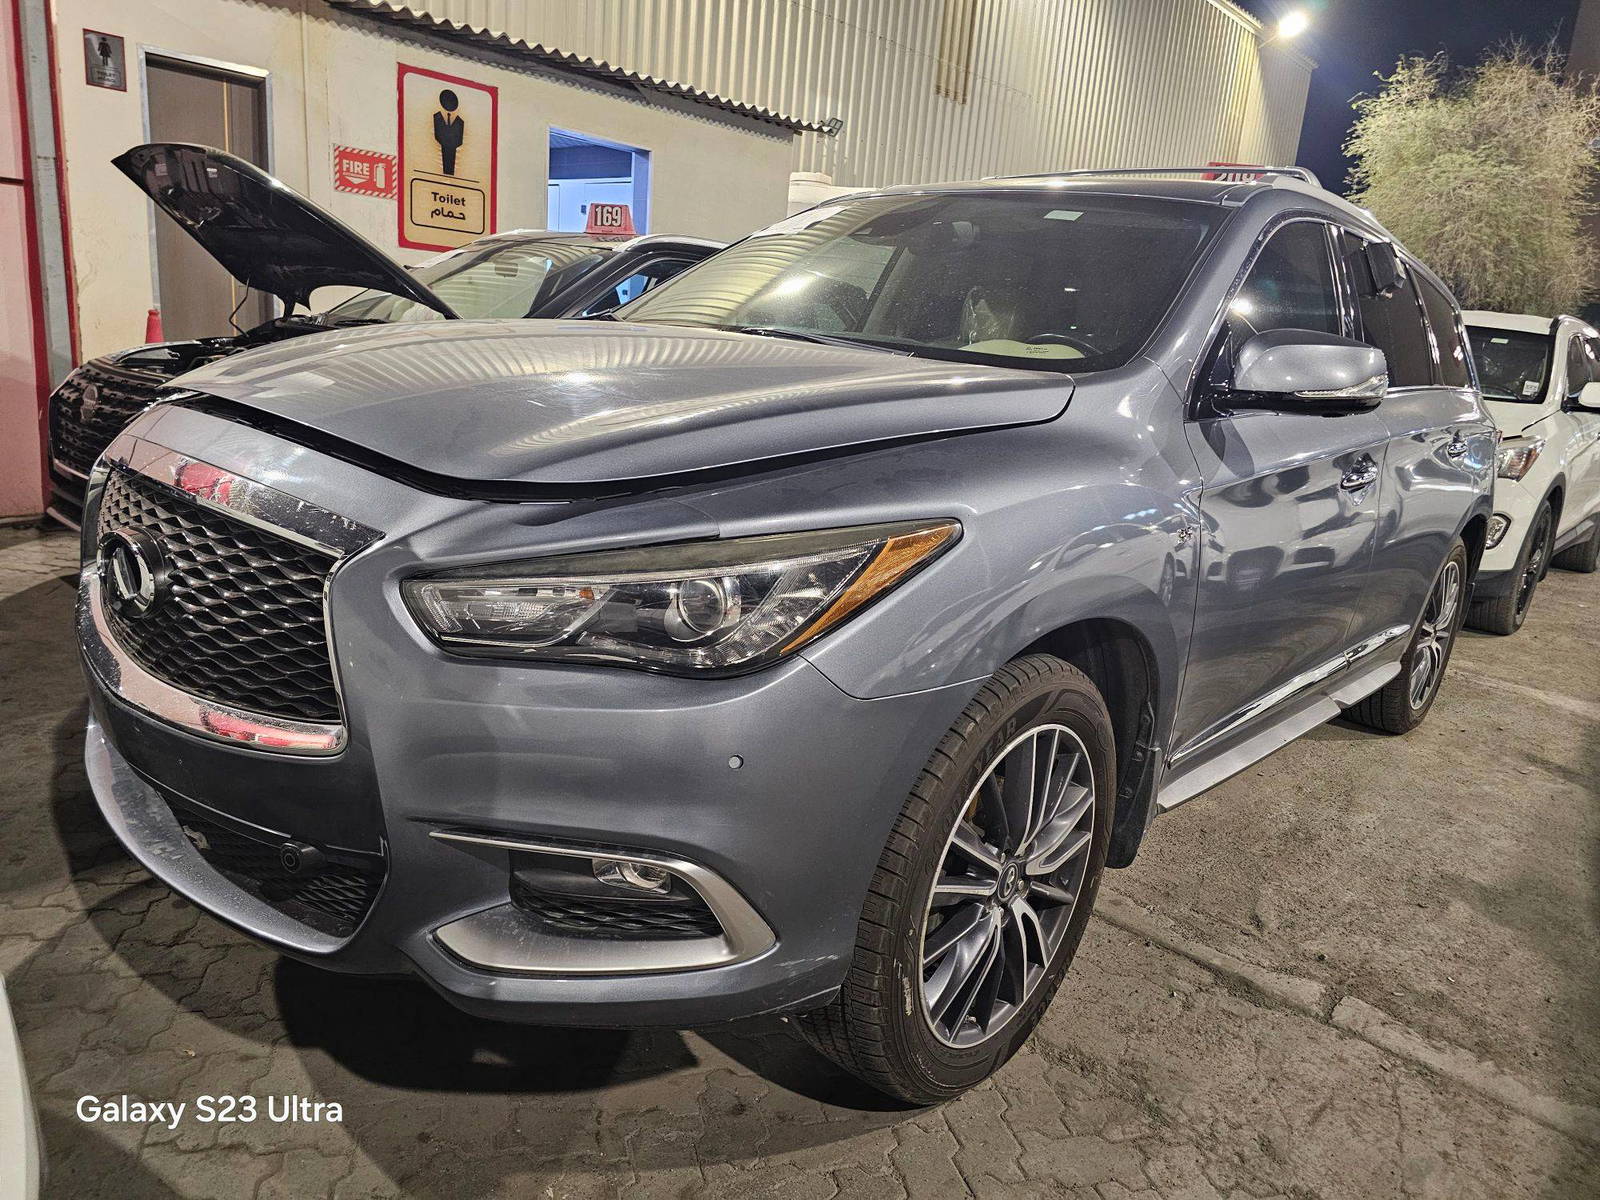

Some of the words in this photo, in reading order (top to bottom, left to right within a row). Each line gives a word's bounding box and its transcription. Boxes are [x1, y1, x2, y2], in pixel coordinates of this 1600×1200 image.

[342, 159, 370, 176] FIRE
[431, 191, 466, 207] Toilet
[430, 206, 466, 221] حمام
[595, 205, 621, 227] 169
